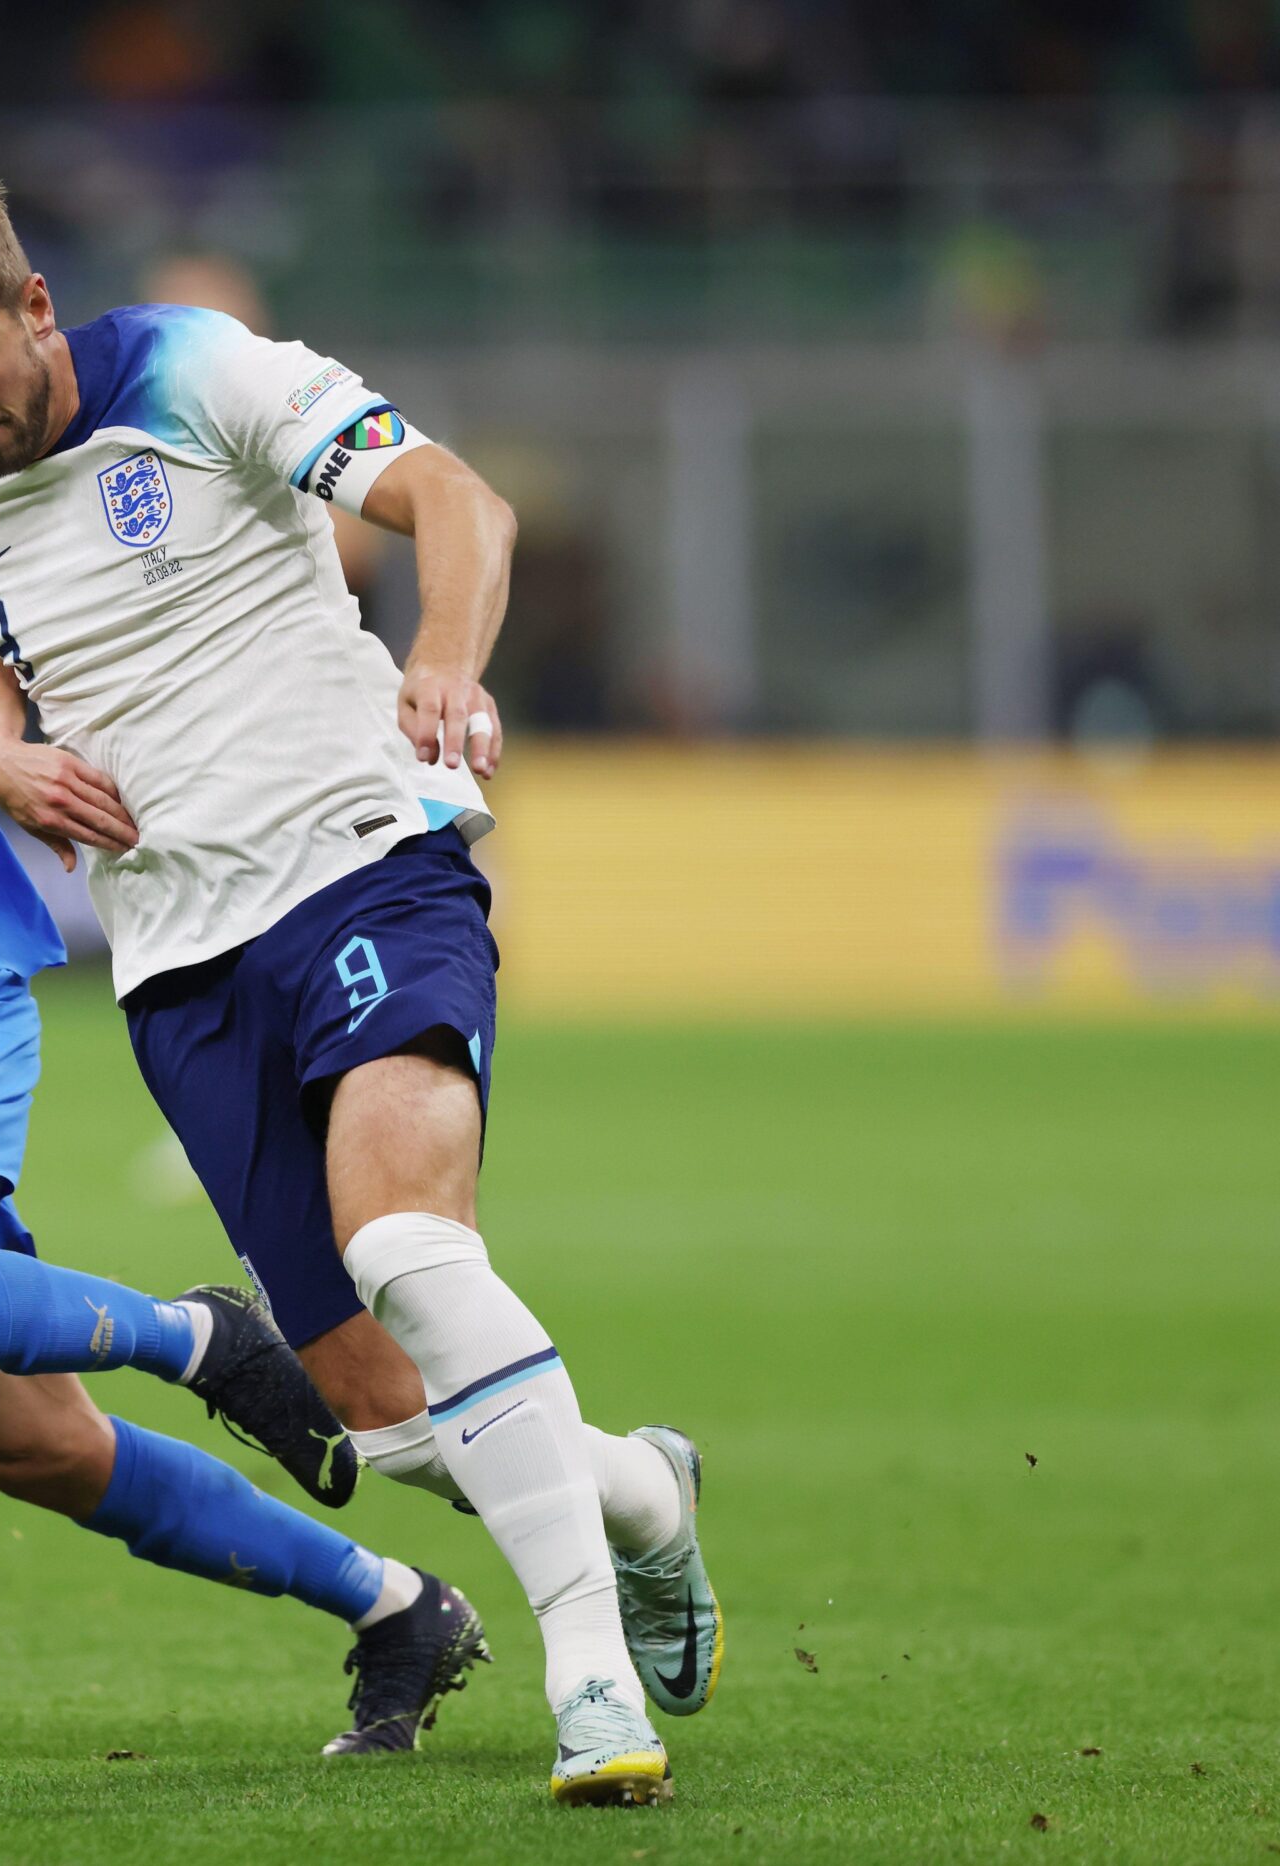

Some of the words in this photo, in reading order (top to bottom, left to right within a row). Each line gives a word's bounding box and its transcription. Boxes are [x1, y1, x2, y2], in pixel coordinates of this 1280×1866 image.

[285, 388, 301, 405] UEFA
[291, 365, 347, 414] FOUNDATION
[316, 447, 352, 502] ONE
[140, 544, 167, 569] ITALY
[334, 935, 389, 1010] 9
